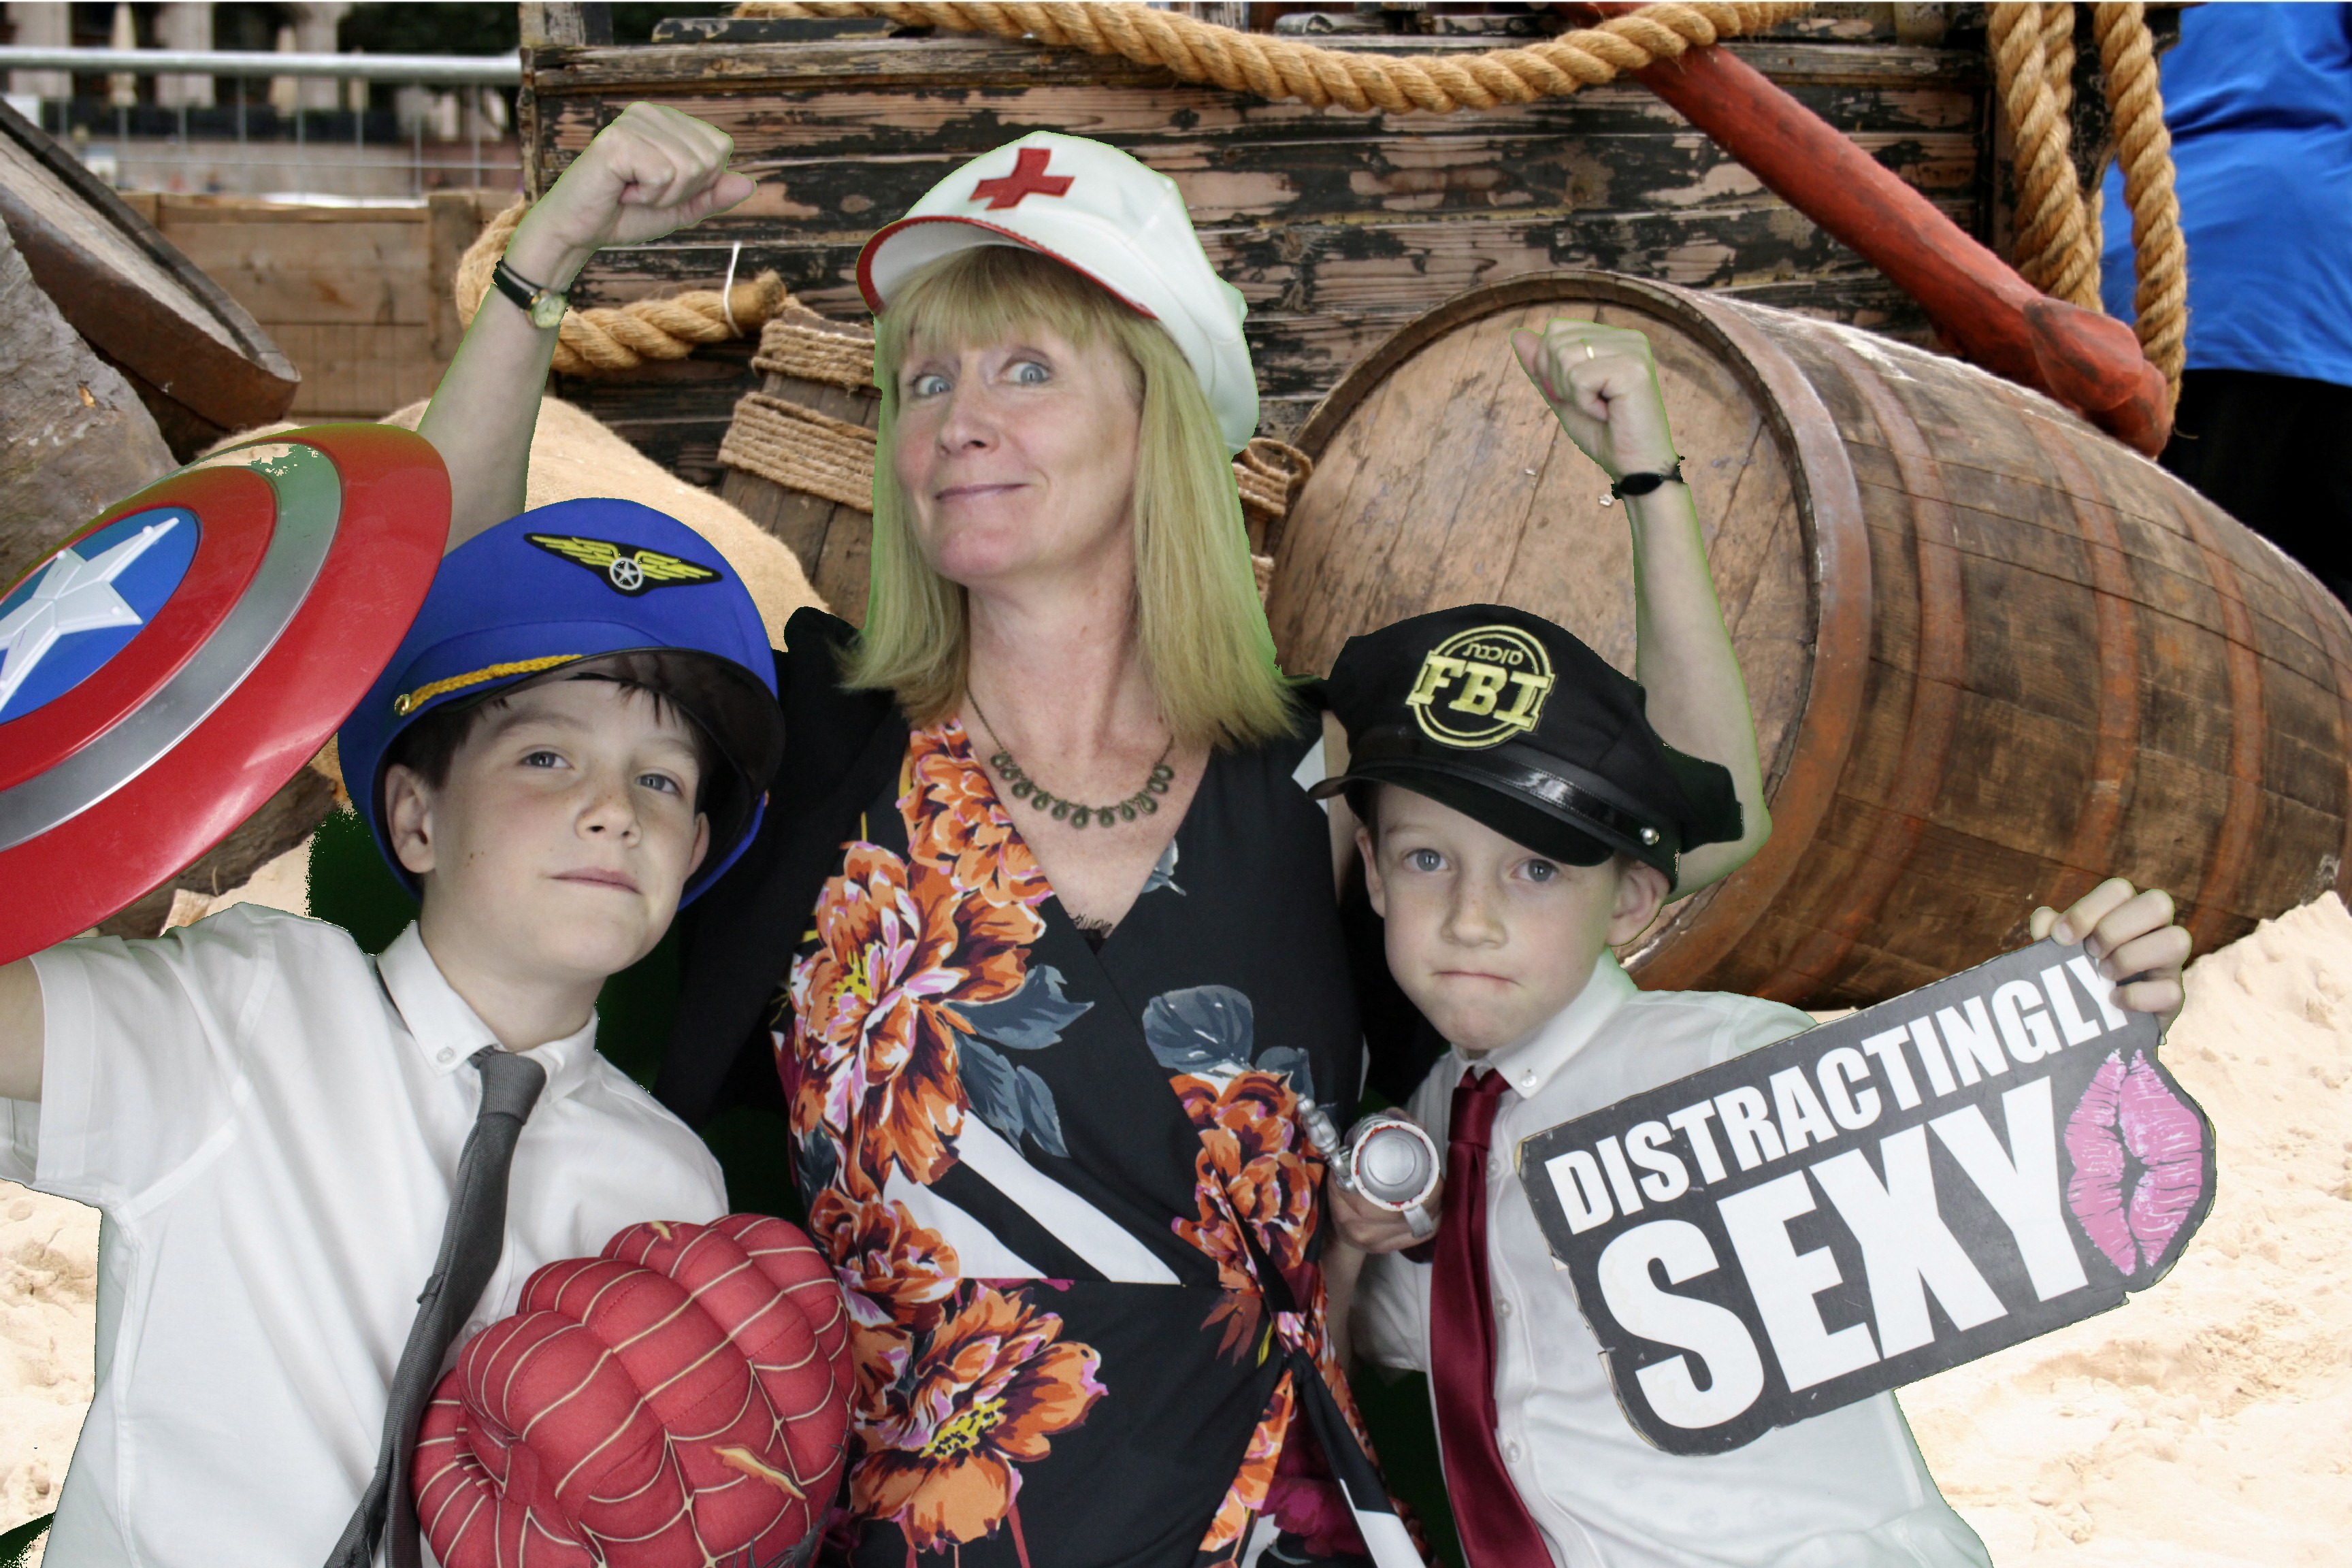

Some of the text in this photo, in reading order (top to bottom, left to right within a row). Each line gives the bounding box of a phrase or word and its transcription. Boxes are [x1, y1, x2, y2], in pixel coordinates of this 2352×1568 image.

[1405, 655, 1550, 728] FBI
[1546, 955, 2129, 1235] DISTRACTINGLY
[1597, 1075, 2089, 1429] SEXY
